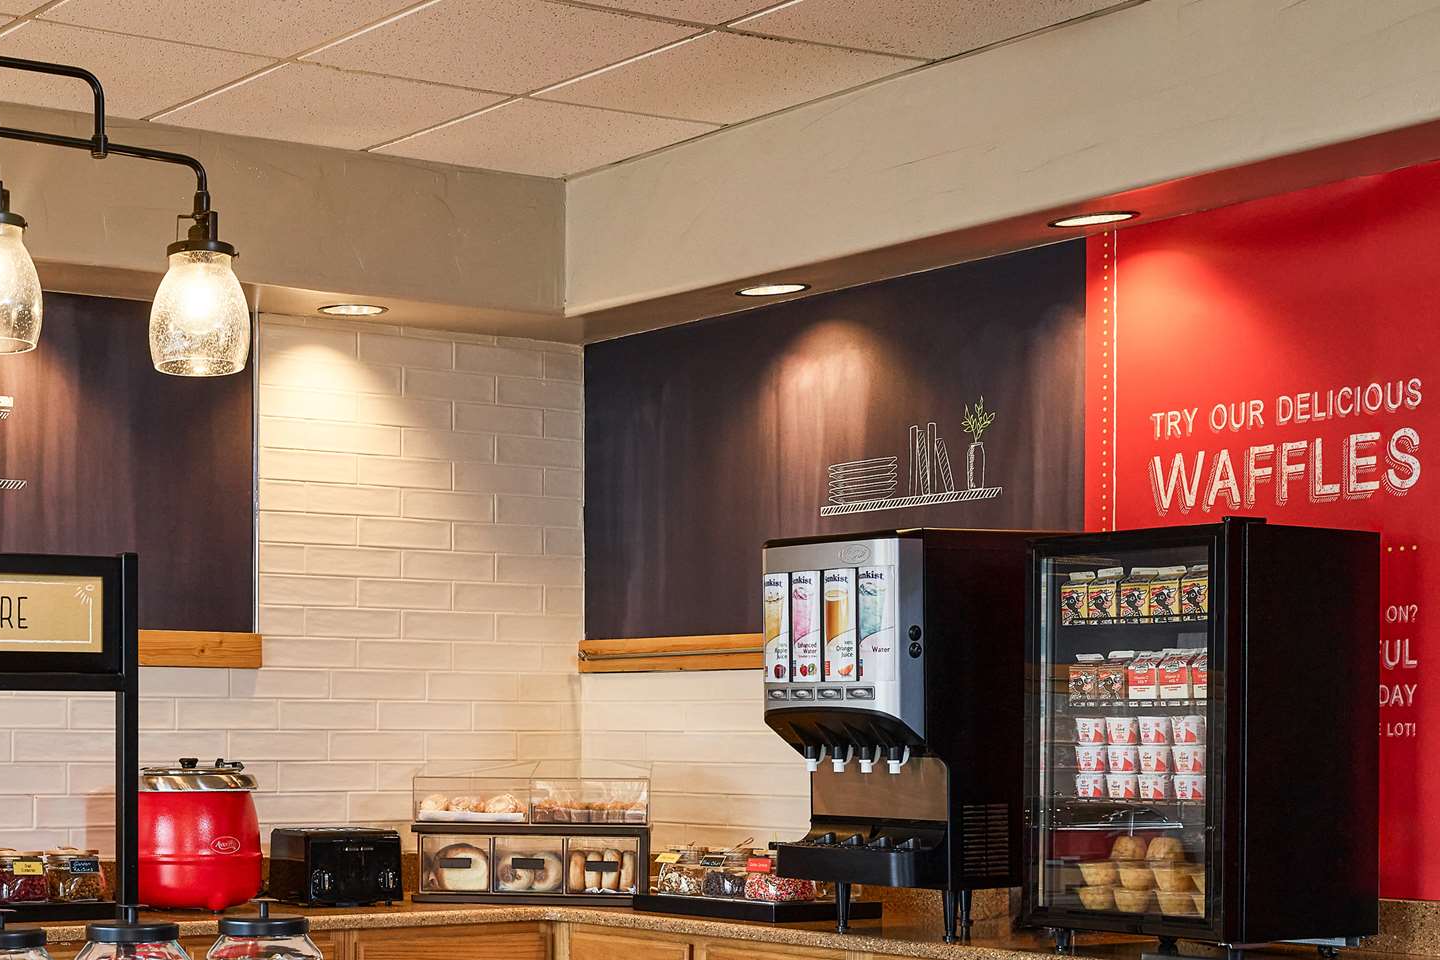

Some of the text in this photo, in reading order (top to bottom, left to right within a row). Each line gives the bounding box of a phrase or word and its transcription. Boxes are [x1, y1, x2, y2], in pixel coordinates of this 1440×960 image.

[1151, 377, 1422, 439] TRY OUR DELICIOUS
[1150, 427, 1421, 513] WAFFLES
[1386, 604, 1418, 623] ON?
[871, 645, 891, 653] Water
[1379, 639, 1418, 669] UL
[1387, 722, 1417, 737] LOT!
